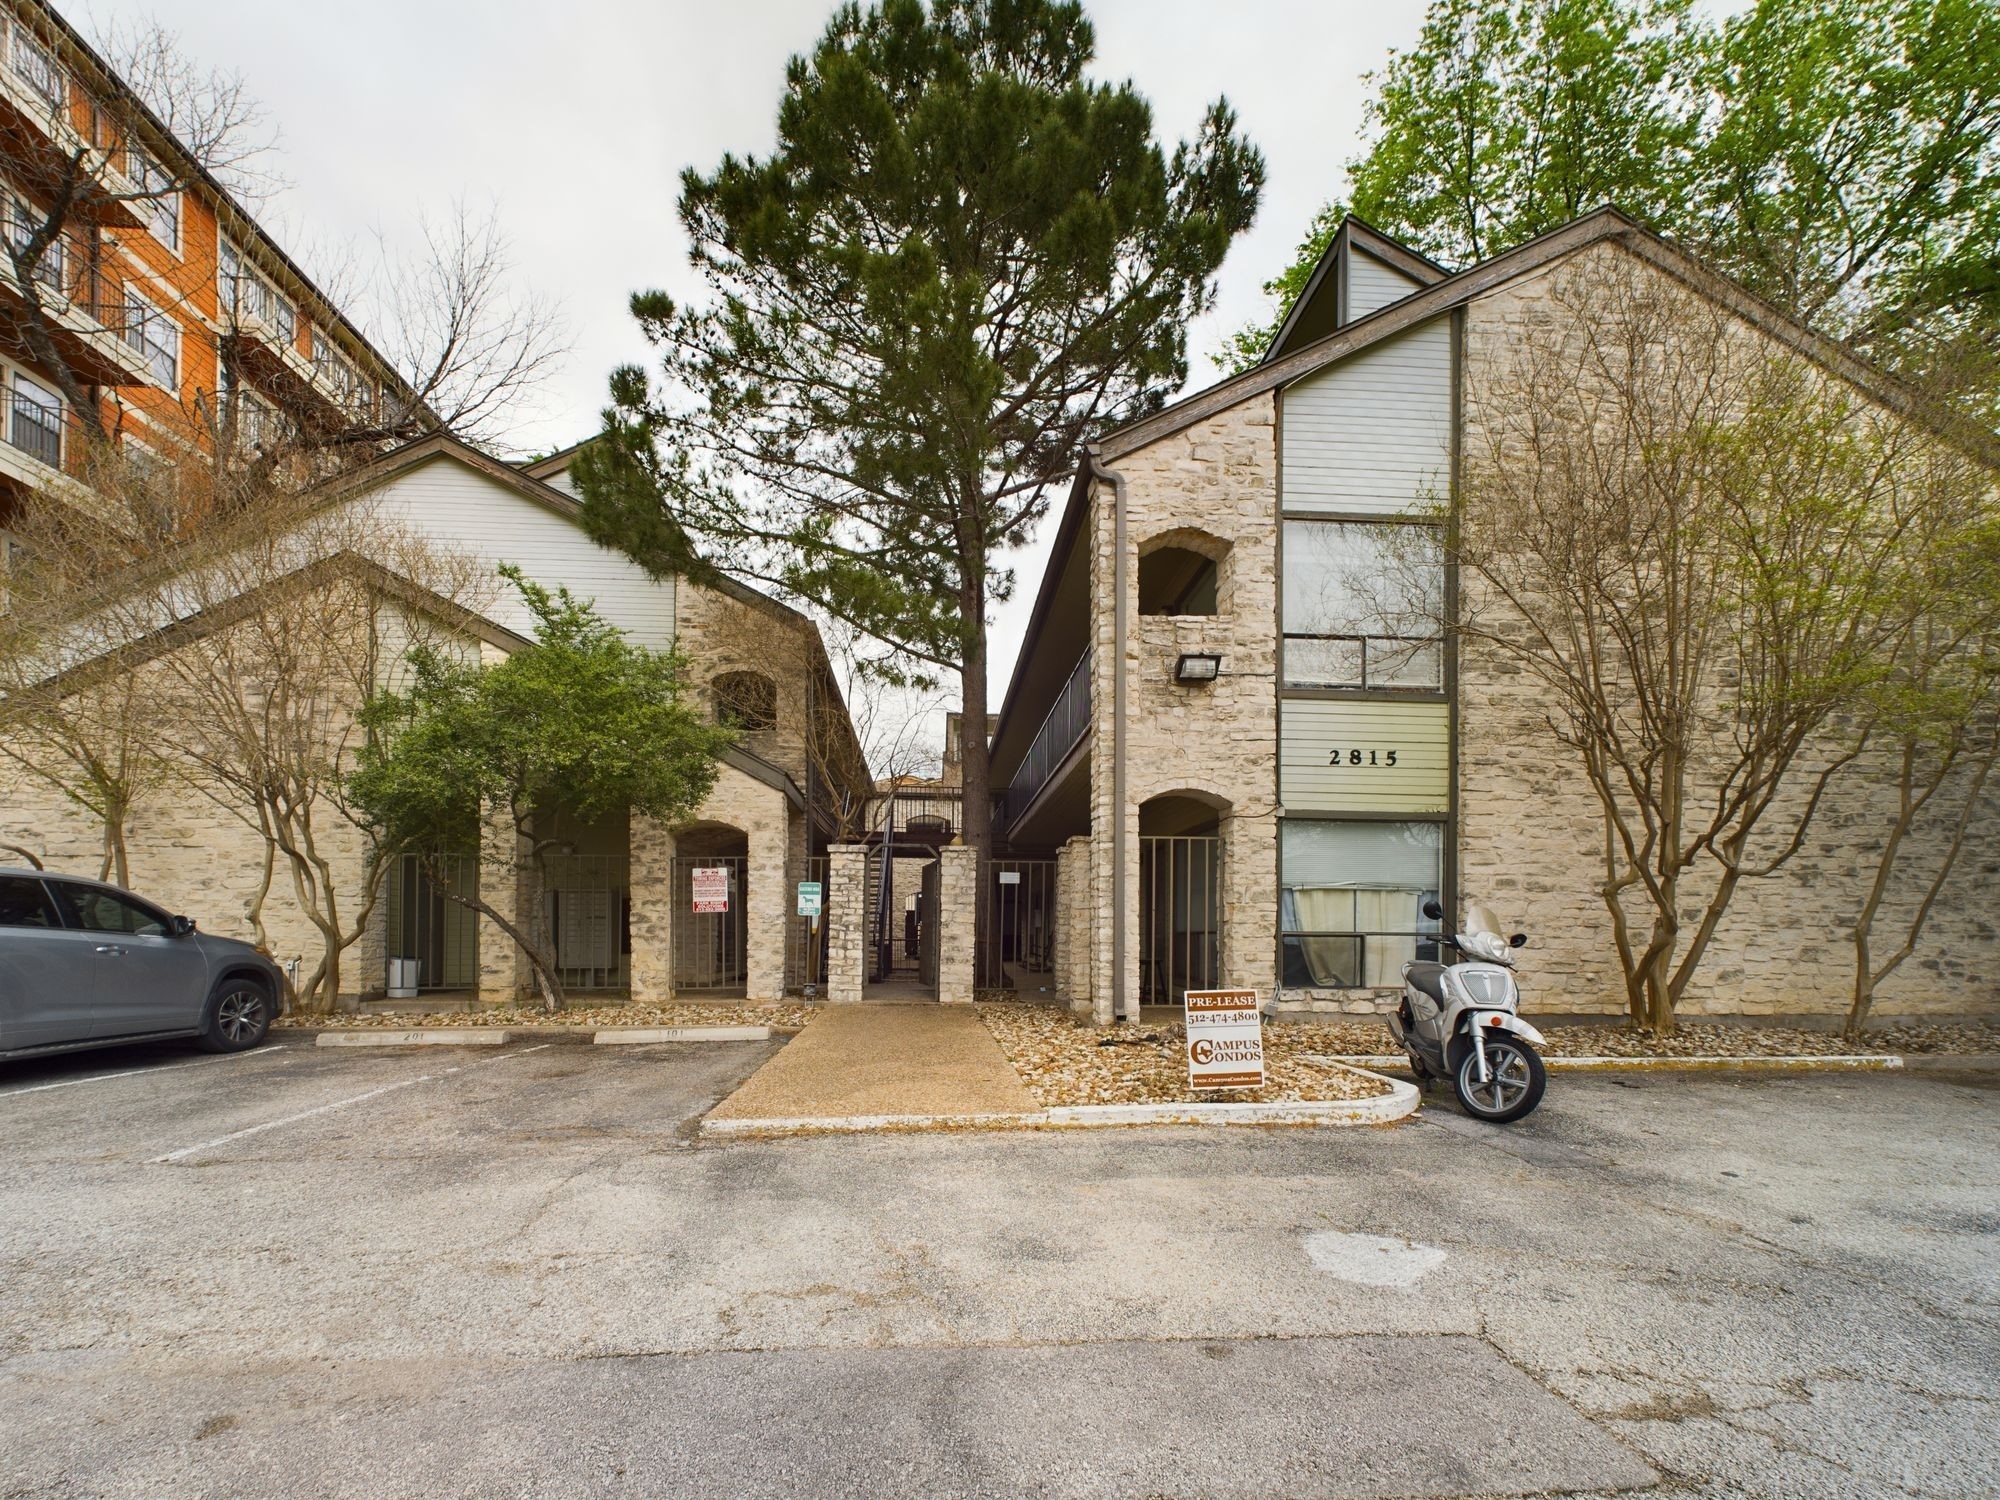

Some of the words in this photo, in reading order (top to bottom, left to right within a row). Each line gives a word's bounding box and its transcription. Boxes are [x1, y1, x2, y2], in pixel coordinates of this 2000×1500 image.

[1329, 749, 1397, 767] 2815
[1188, 996, 1256, 1007] PRE-LEASE
[1188, 1012, 1258, 1025] 512-474-4800
[404, 1032, 424, 1041] 201
